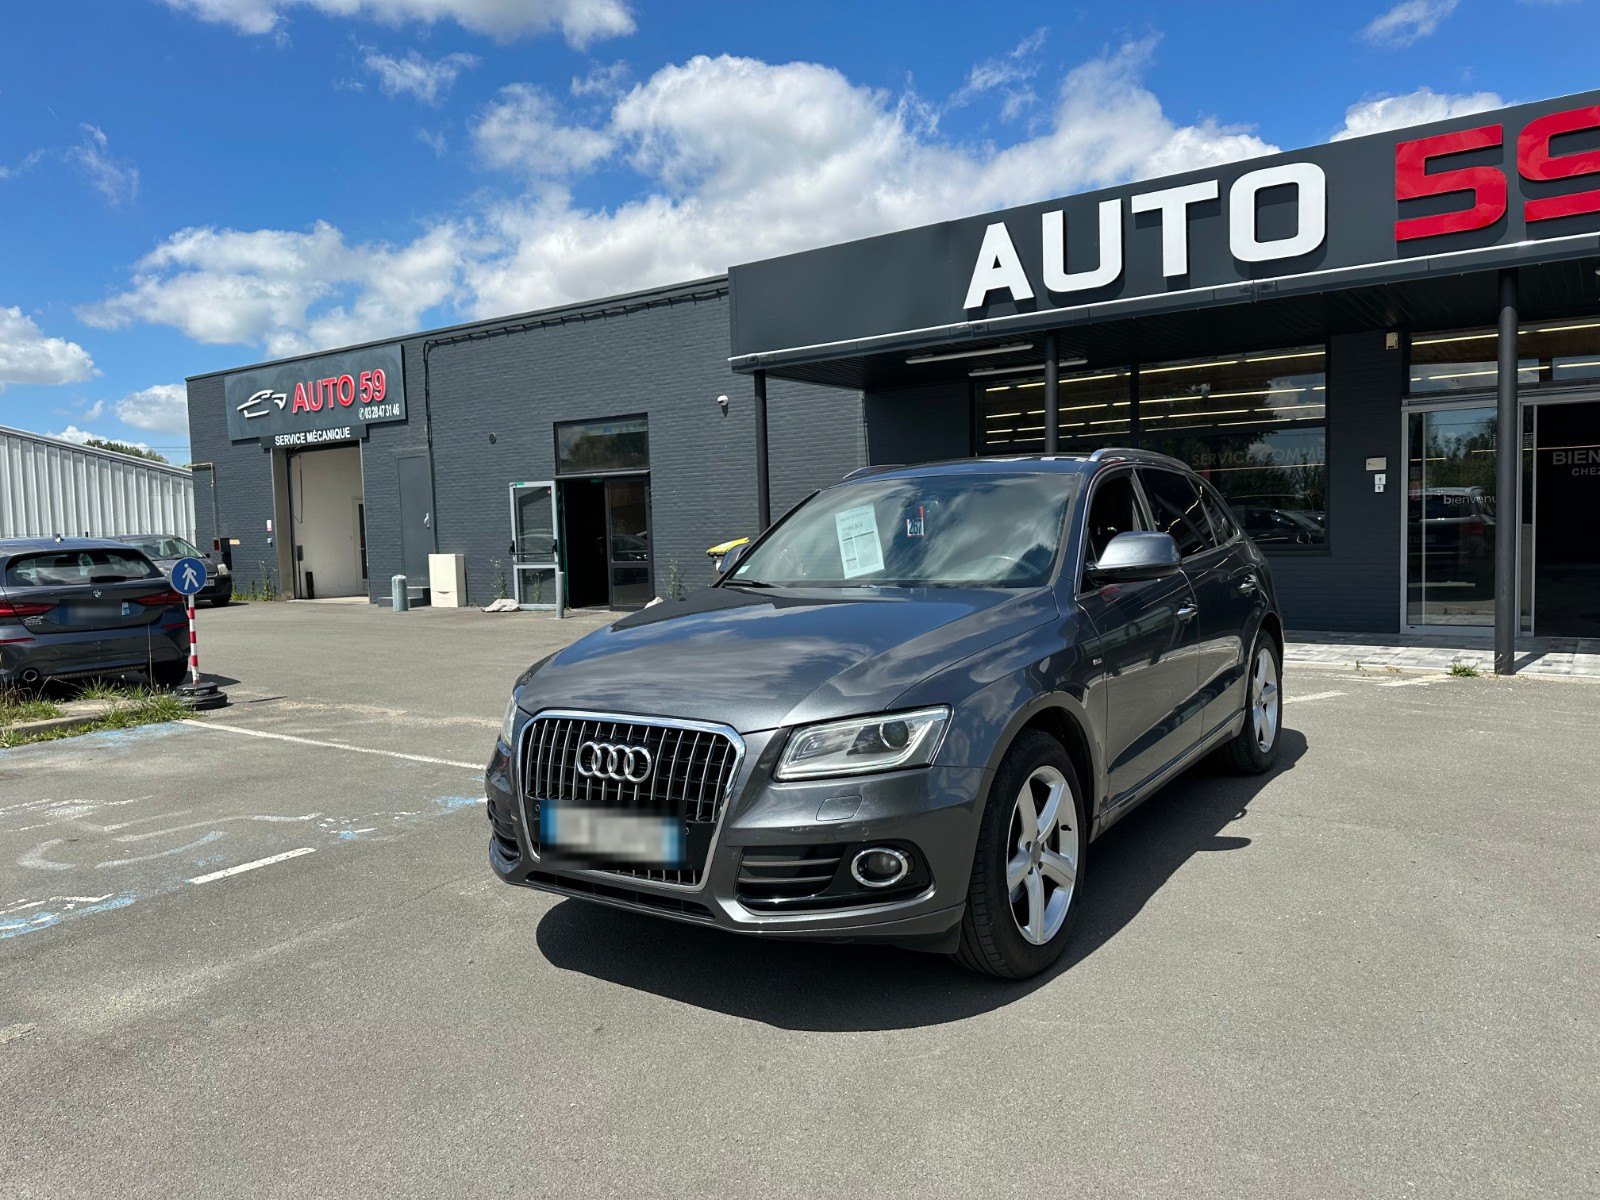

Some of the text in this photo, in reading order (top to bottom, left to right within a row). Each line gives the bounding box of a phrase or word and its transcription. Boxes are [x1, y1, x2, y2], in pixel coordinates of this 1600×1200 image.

[963, 104, 1600, 309] AUTO 59
[292, 369, 386, 413] AUTO 59
[275, 427, 351, 446] SERVICE MÉCANIQUE
[1552, 449, 1600, 465] BIEN
[909, 519, 922, 535] 267
